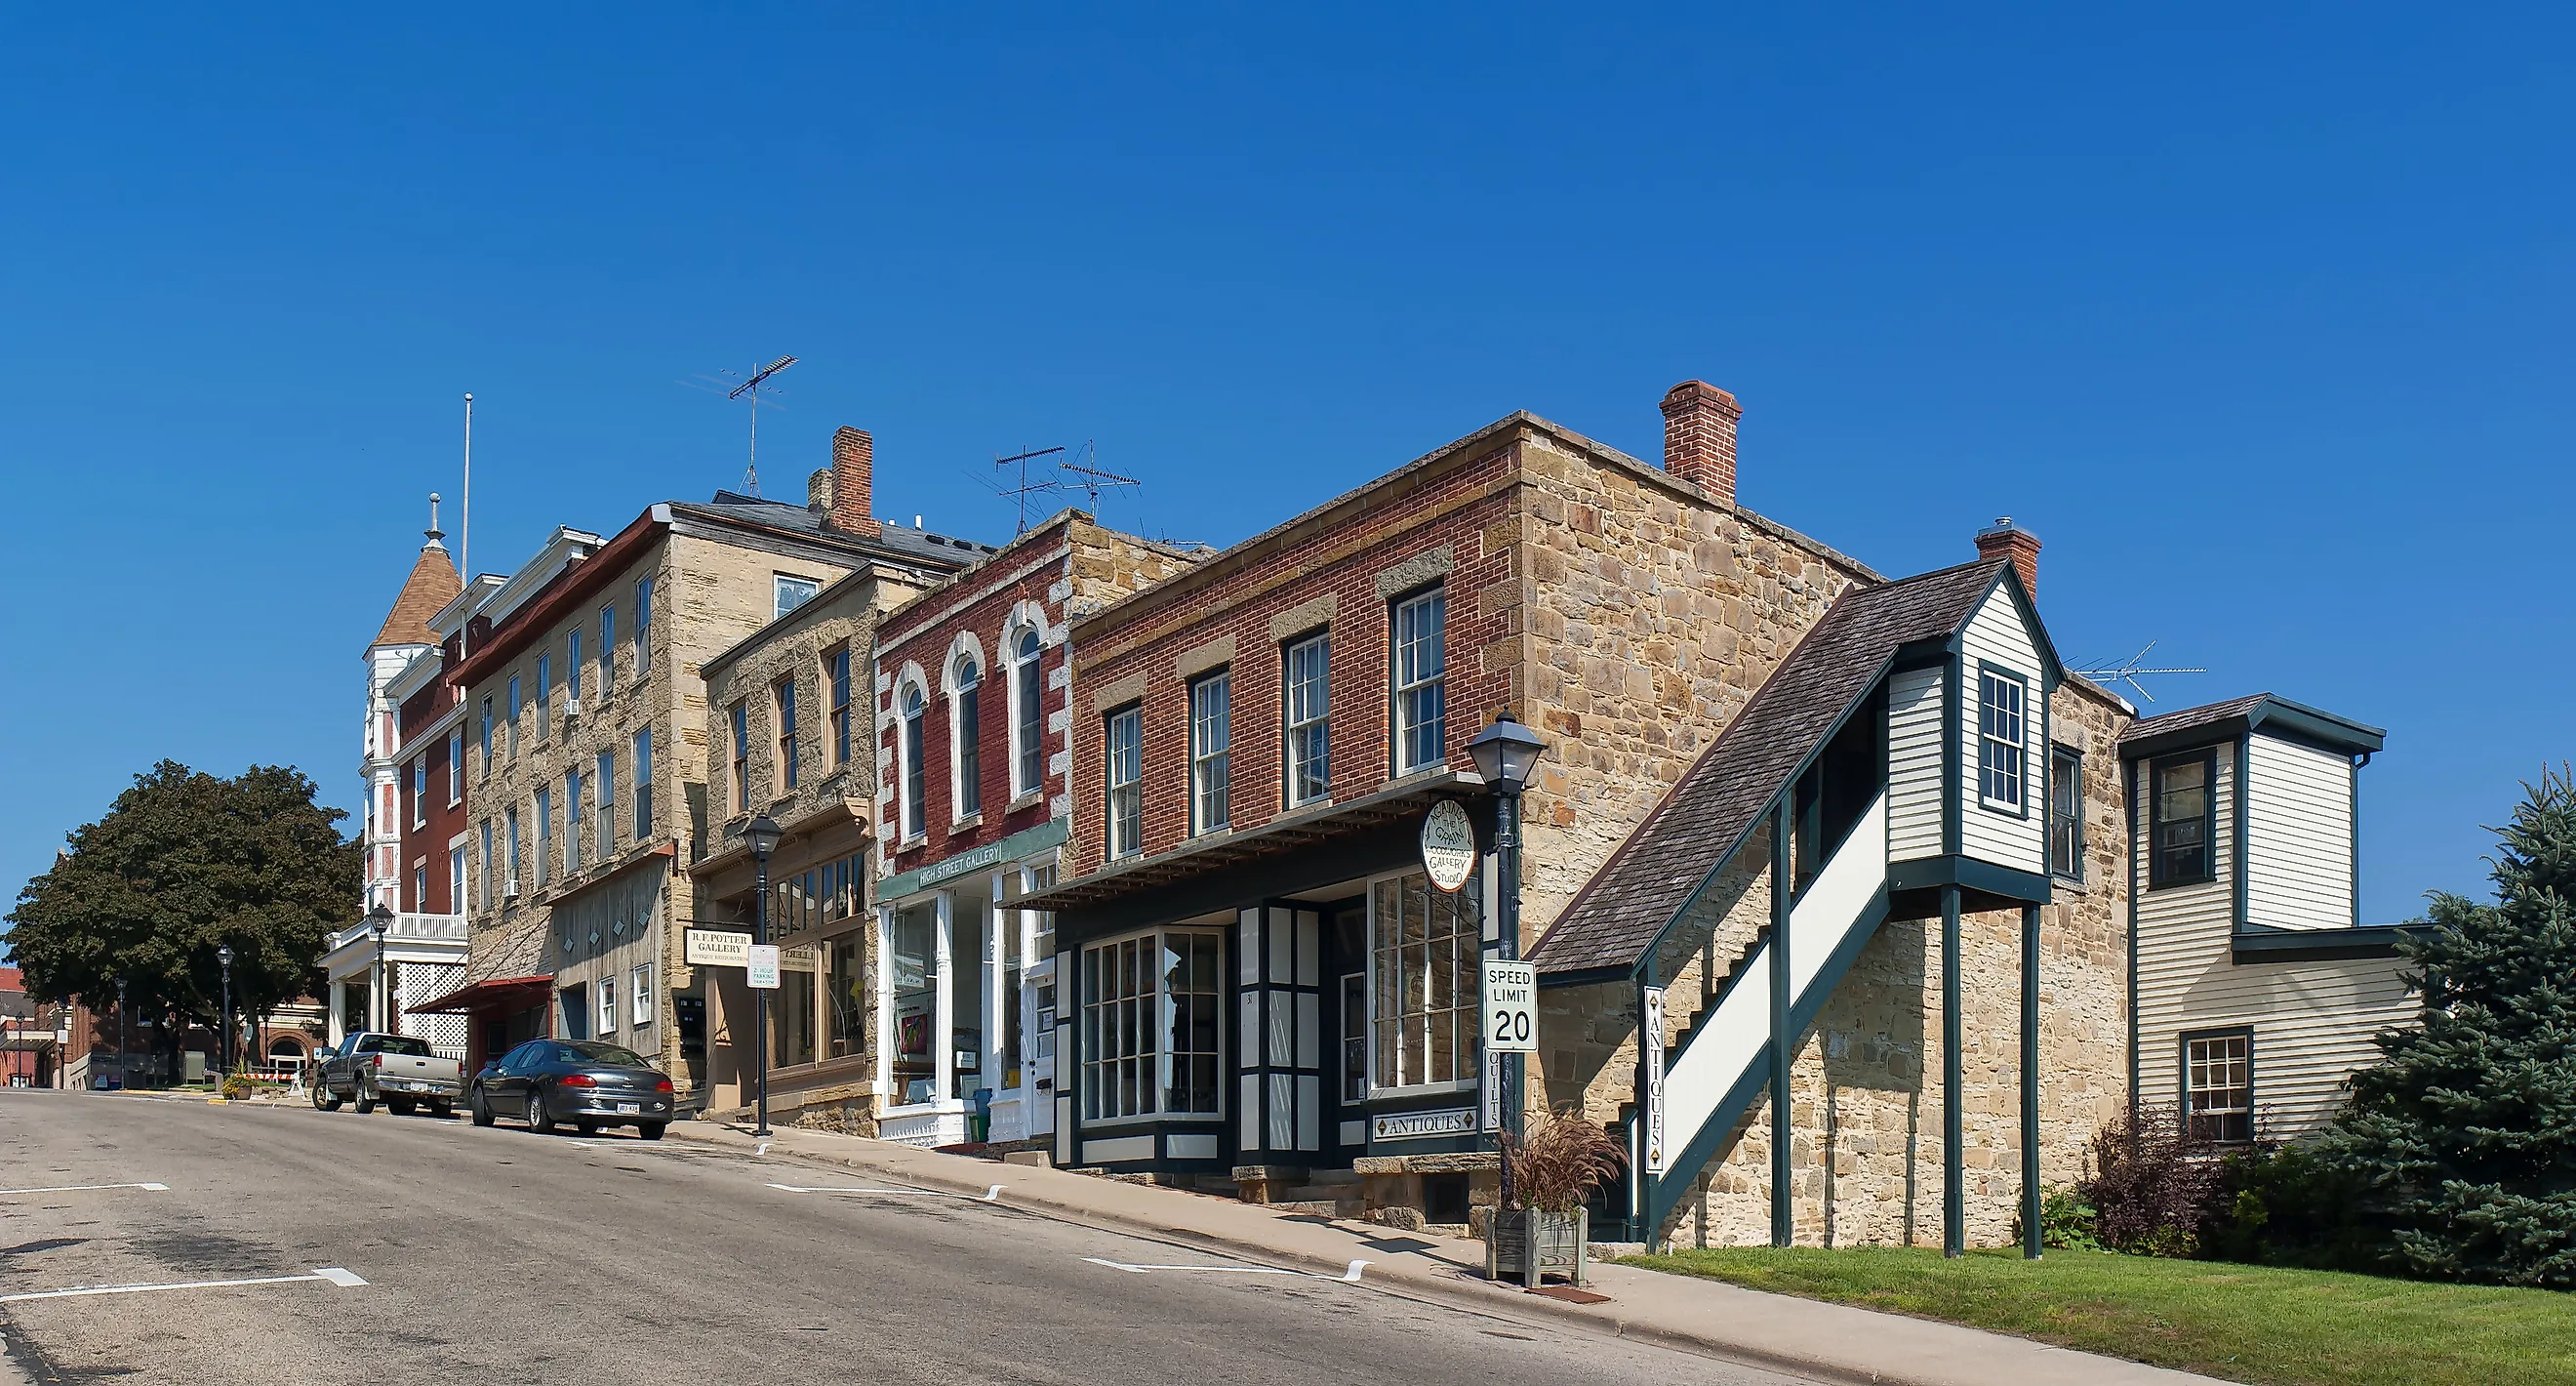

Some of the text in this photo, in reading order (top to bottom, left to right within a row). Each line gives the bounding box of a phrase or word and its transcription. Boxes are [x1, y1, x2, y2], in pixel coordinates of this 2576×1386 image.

[1429, 800, 1469, 825] AGAINST
[1443, 819, 1456, 828] THE
[1435, 827, 1464, 845] GRAIN
[1425, 844, 1471, 858] WOODWORKS
[920, 845, 999, 884] HIGH STREET GALLERY
[1429, 857, 1468, 872] GALLERY
[1434, 870, 1463, 883] STUDIO
[710, 934, 747, 944] POTTER
[698, 943, 742, 954] GALLERY
[1489, 969, 1531, 985] SPEED
[1493, 989, 1528, 1003] LIMIT
[1495, 1009, 1530, 1041] 20
[1489, 1051, 1499, 1125] QUILTS
[1649, 1016, 1662, 1146] ANTIQUES
[1389, 1114, 1462, 1134] ANTIQUES
